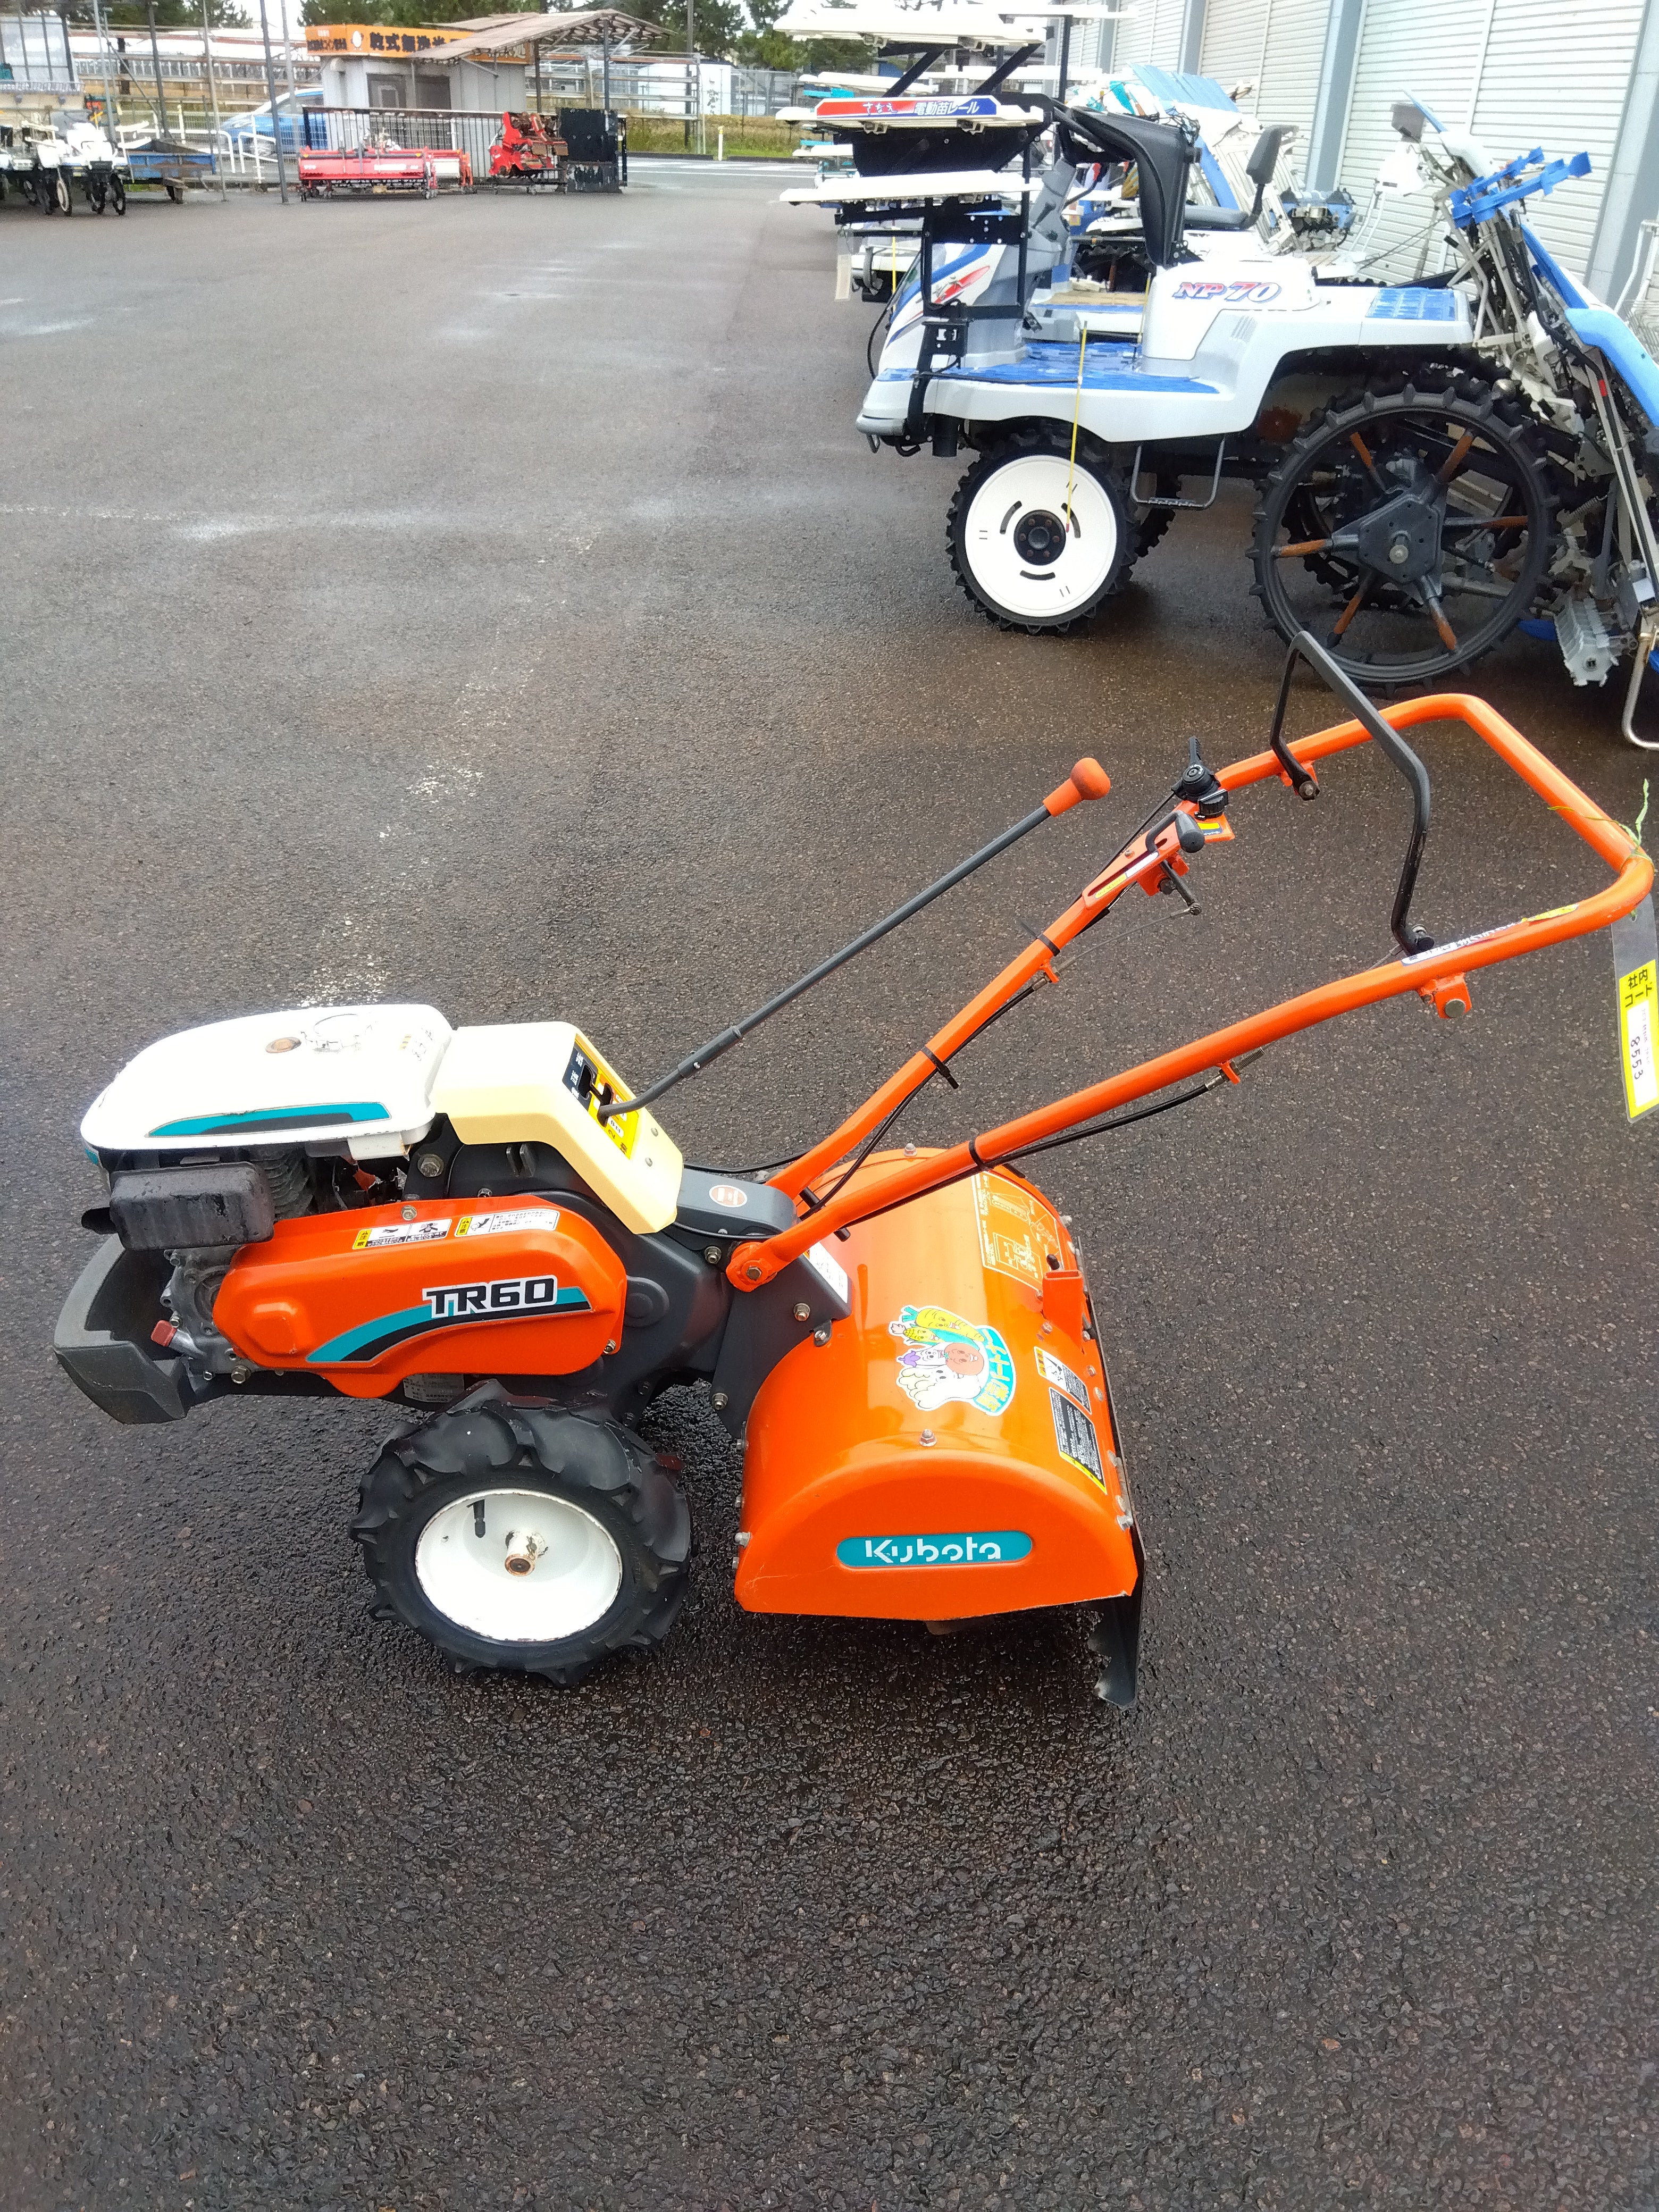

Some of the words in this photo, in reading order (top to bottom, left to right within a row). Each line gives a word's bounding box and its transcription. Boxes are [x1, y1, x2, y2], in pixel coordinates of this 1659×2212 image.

[913, 102, 980, 116] 電動苗レール
[1628, 969, 1648, 990] 社内
[1625, 982, 1653, 1008] コード
[1630, 1036, 1644, 1080] 8553
[425, 1277, 556, 1316] TR60
[865, 1536, 1001, 1564] Kubota
